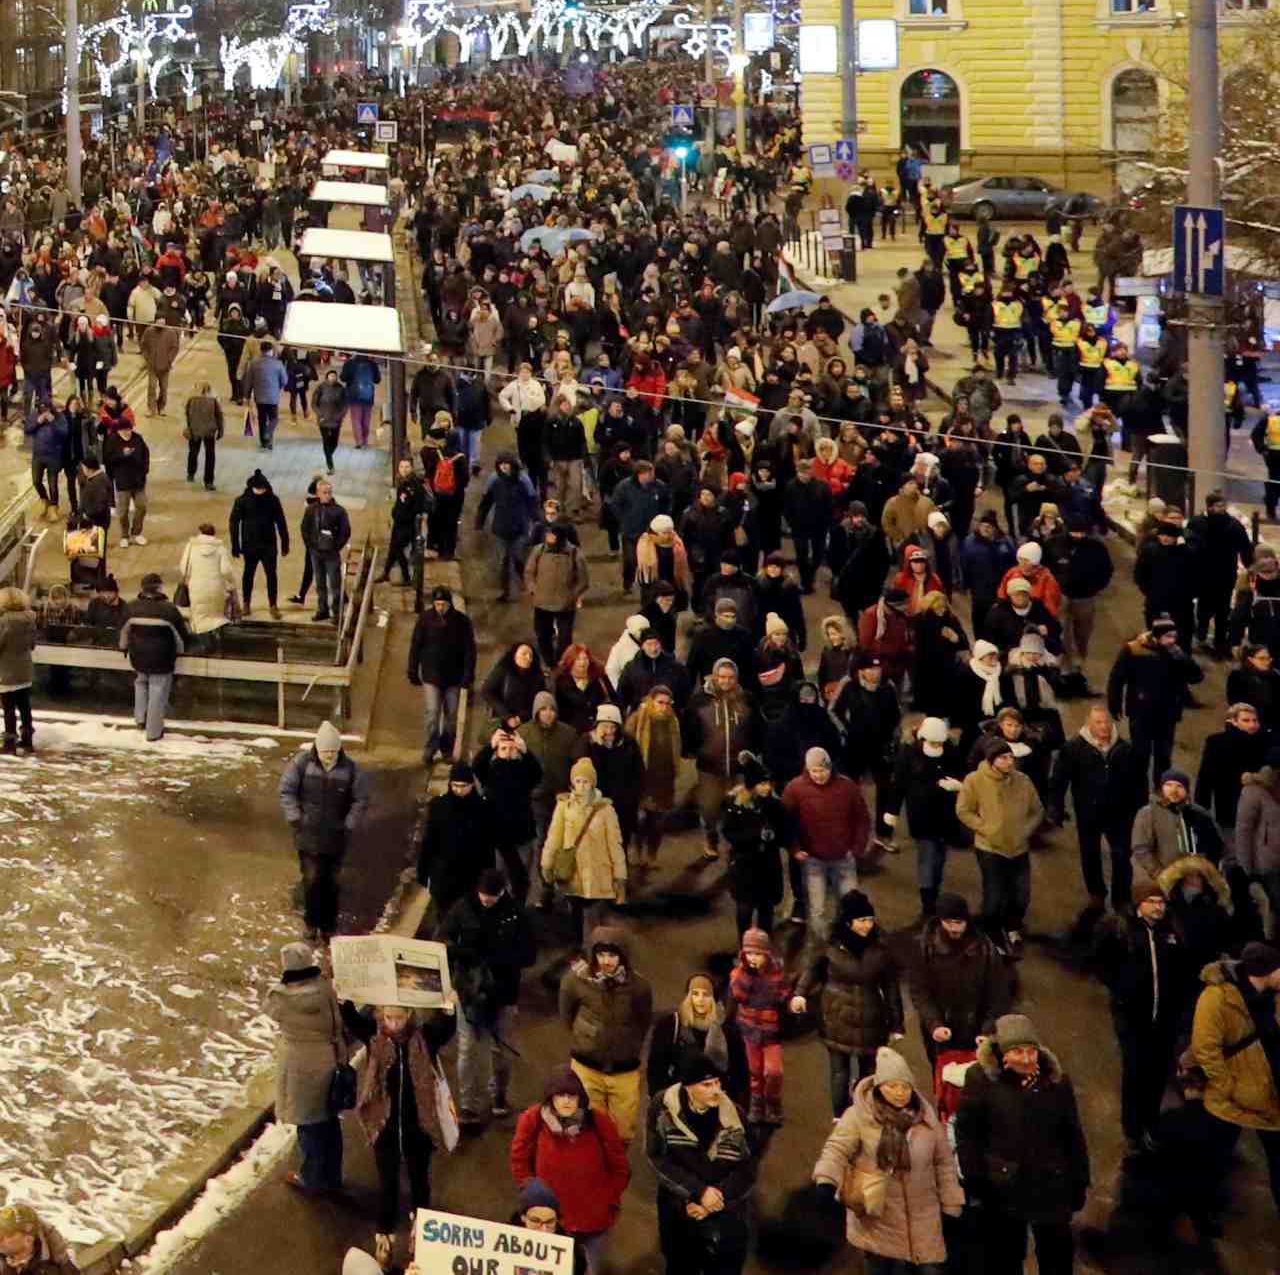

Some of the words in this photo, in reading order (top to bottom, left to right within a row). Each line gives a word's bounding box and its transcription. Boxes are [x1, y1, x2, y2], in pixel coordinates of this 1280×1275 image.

[423, 1219, 485, 1249] SORRY
[493, 1233, 567, 1265] ABOUT
[452, 1255, 500, 1275] OUR
